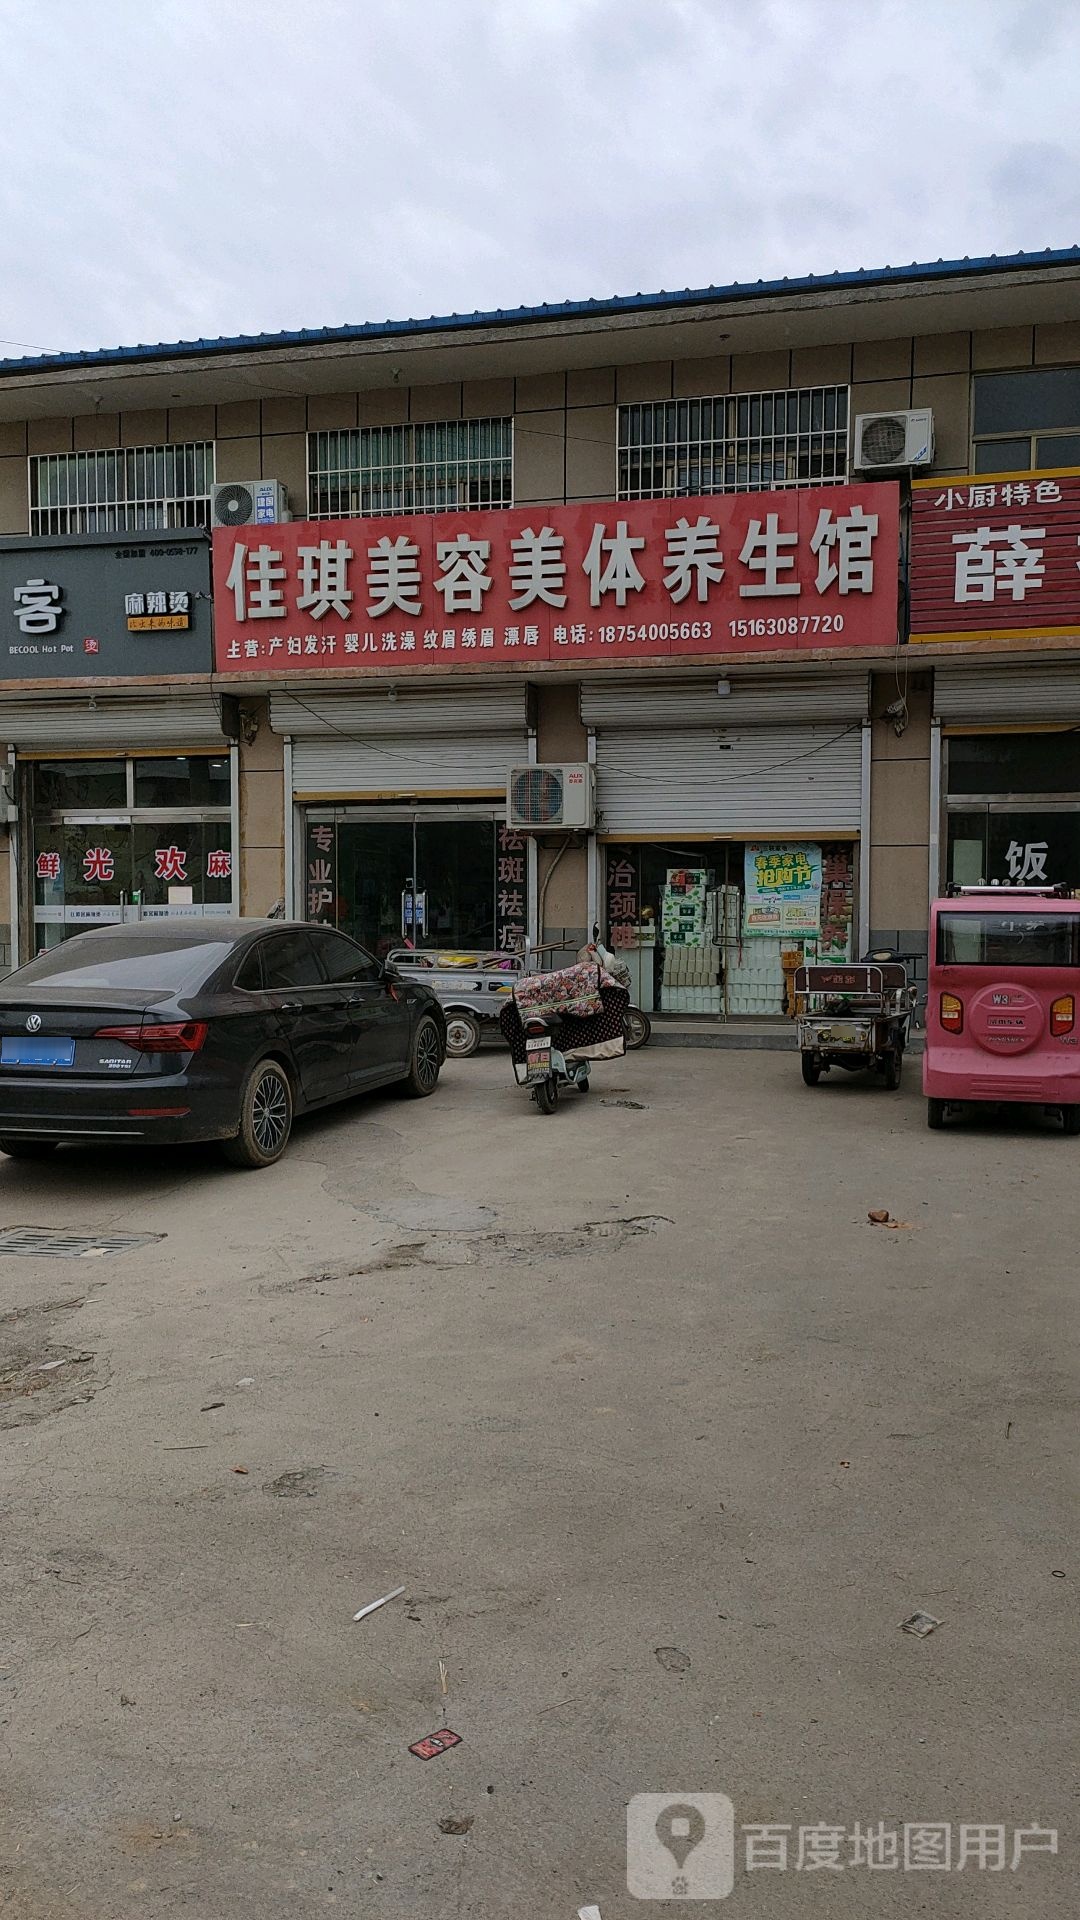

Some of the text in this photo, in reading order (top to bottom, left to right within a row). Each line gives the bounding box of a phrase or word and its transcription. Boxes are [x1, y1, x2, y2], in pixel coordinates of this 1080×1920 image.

[934, 480, 1063, 511] 小厨特色
[225, 504, 879, 622] 佳琪美容美体养生馆
[952, 524, 1080, 603] 薛
[13, 578, 63, 634] 客
[124, 591, 189, 615] 麻辣烫
[9, 644, 74, 655] BECOOL Hot Pot
[344, 632, 417, 655] 婴儿洗澡
[503, 625, 540, 648] 漂唇
[728, 614, 845, 638] 15163087720
[36, 845, 232, 881] 鲜 光 欢 麻
[308, 825, 335, 928] 专业护
[755, 852, 808, 869] 春季家电
[755, 865, 812, 887] 抢购节
[1004, 840, 1049, 881] 饭
[607, 846, 640, 950] 治颈椎
[992, 994, 1009, 1004] W3
